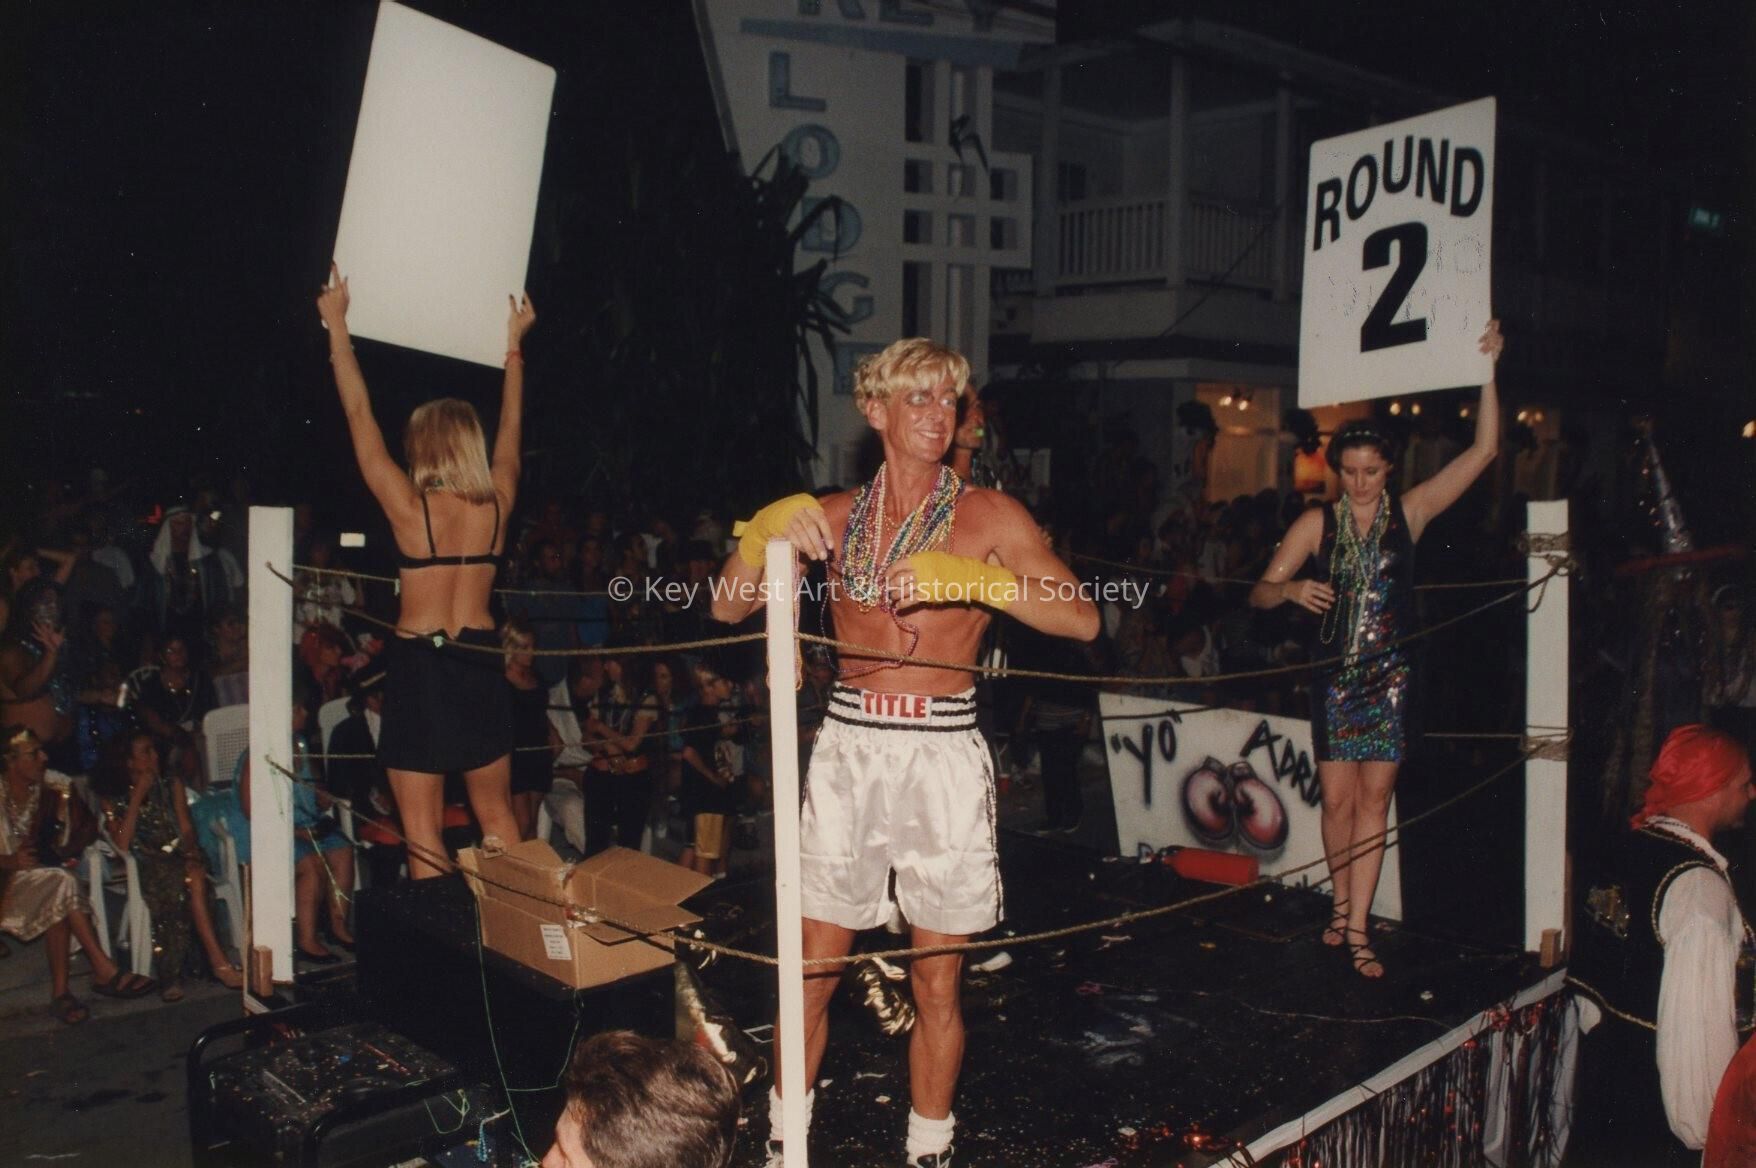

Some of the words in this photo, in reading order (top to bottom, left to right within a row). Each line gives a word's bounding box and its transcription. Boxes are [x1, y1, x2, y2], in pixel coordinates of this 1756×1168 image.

[1313, 135, 1485, 251] ROUND
[1360, 221, 1428, 353] 2
[863, 693, 927, 719] TITLE
